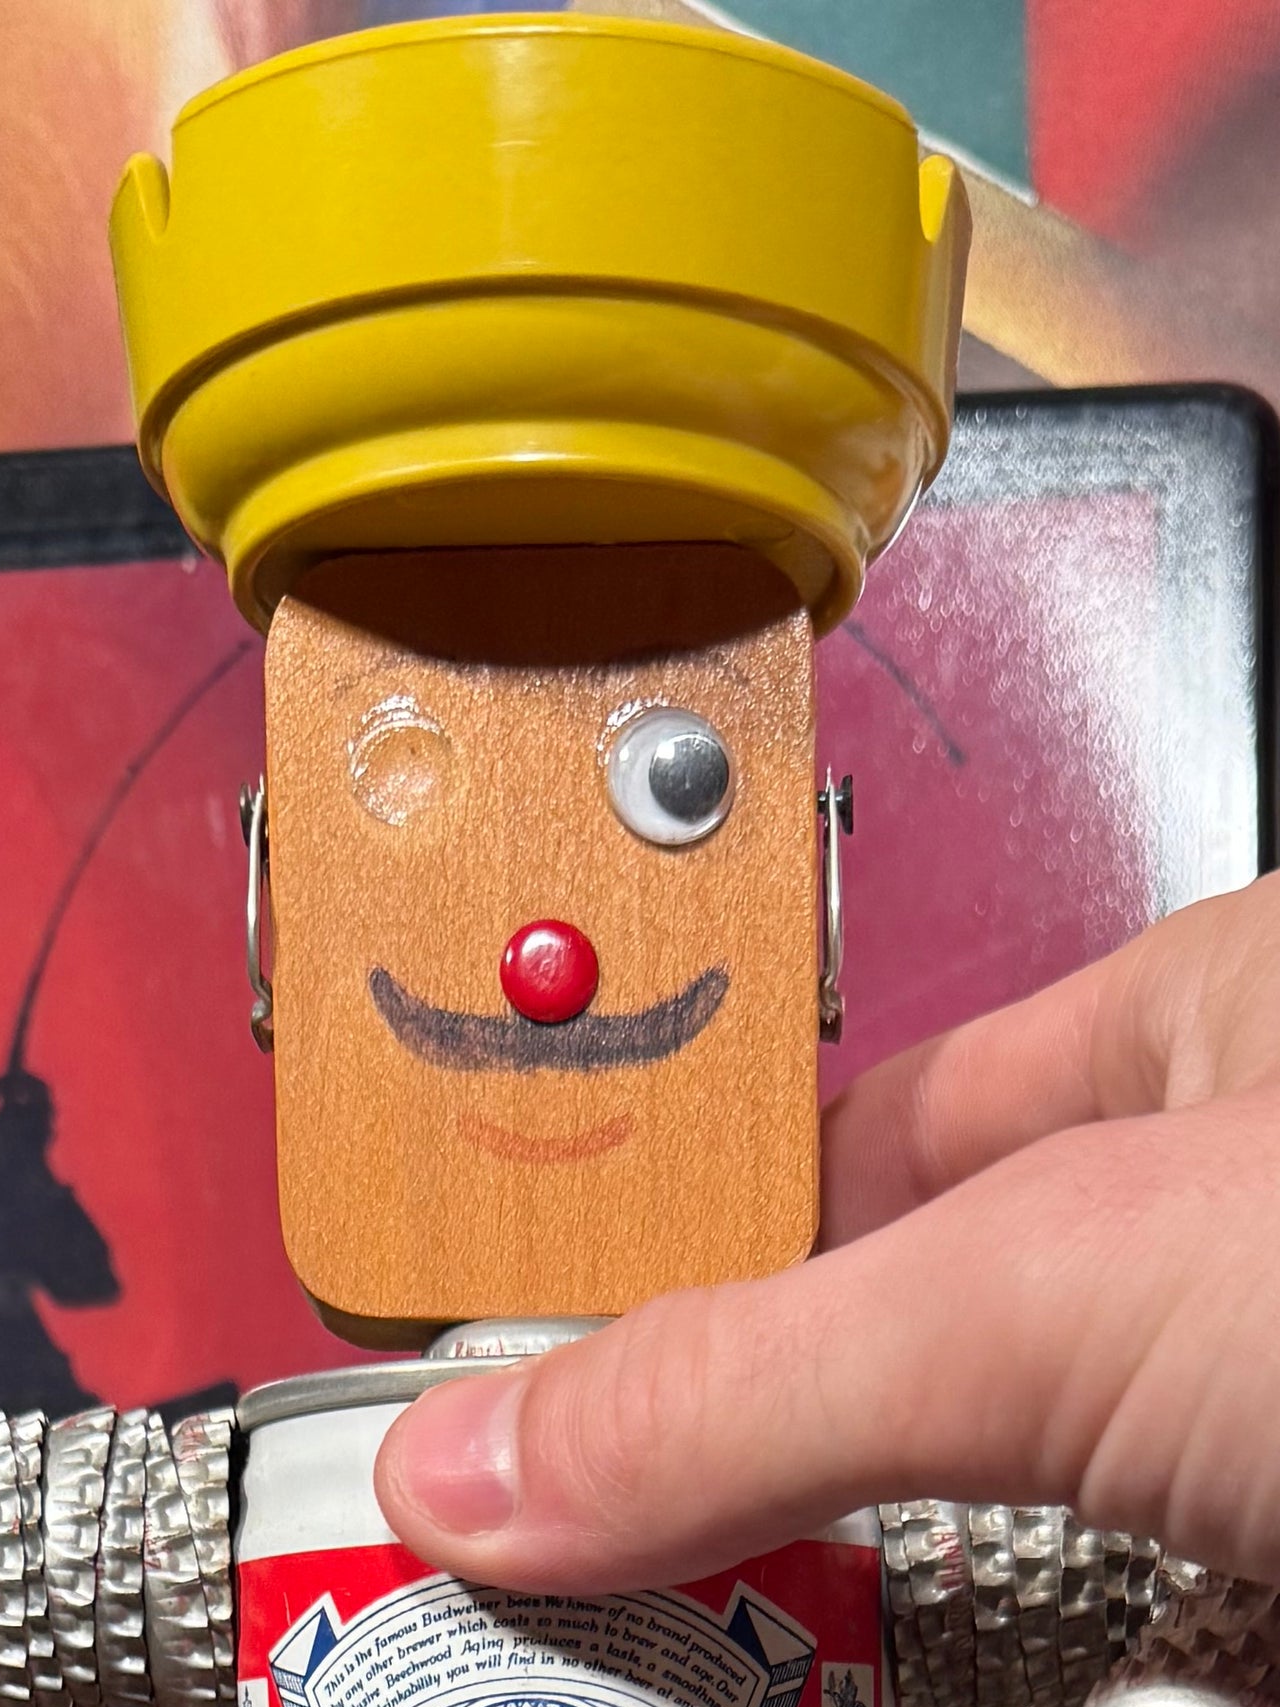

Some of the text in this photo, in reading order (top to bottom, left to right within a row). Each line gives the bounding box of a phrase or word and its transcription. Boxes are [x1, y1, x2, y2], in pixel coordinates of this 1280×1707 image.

[323, 1675, 346, 1697] This
[344, 1661, 355, 1675] is
[355, 1646, 372, 1668] the
[375, 1620, 418, 1652] famous
[421, 1599, 500, 1627] Budweiser
[567, 1596, 604, 1613] know
[608, 1606, 627, 1622] of
[627, 1611, 644, 1626] no
[647, 1617, 690, 1646] brand
[690, 1638, 748, 1688] produced
[344, 1679, 364, 1702] any
[365, 1657, 394, 1682] other
[397, 1632, 443, 1660] brewer
[447, 1618, 488, 1639] which
[493, 1613, 530, 1628] costs
[558, 1617, 598, 1633] much
[604, 1623, 618, 1637] to
[622, 1630, 658, 1650] brew
[660, 1645, 688, 1668] and
[716, 1678, 740, 1703] Our
[385, 1645, 453, 1690] Beechwood
[461, 1635, 504, 1657] Aging
[513, 1634, 581, 1650] produces
[590, 1643, 599, 1652] a
[647, 1662, 657, 1672] a
[447, 1665, 470, 1684] you
[475, 1653, 502, 1670] will
[507, 1652, 536, 1670] find
[541, 1649, 555, 1665] in
[562, 1657, 579, 1668] no
[584, 1658, 622, 1678] other
[624, 1669, 654, 1691] beer
[657, 1686, 672, 1700] at
